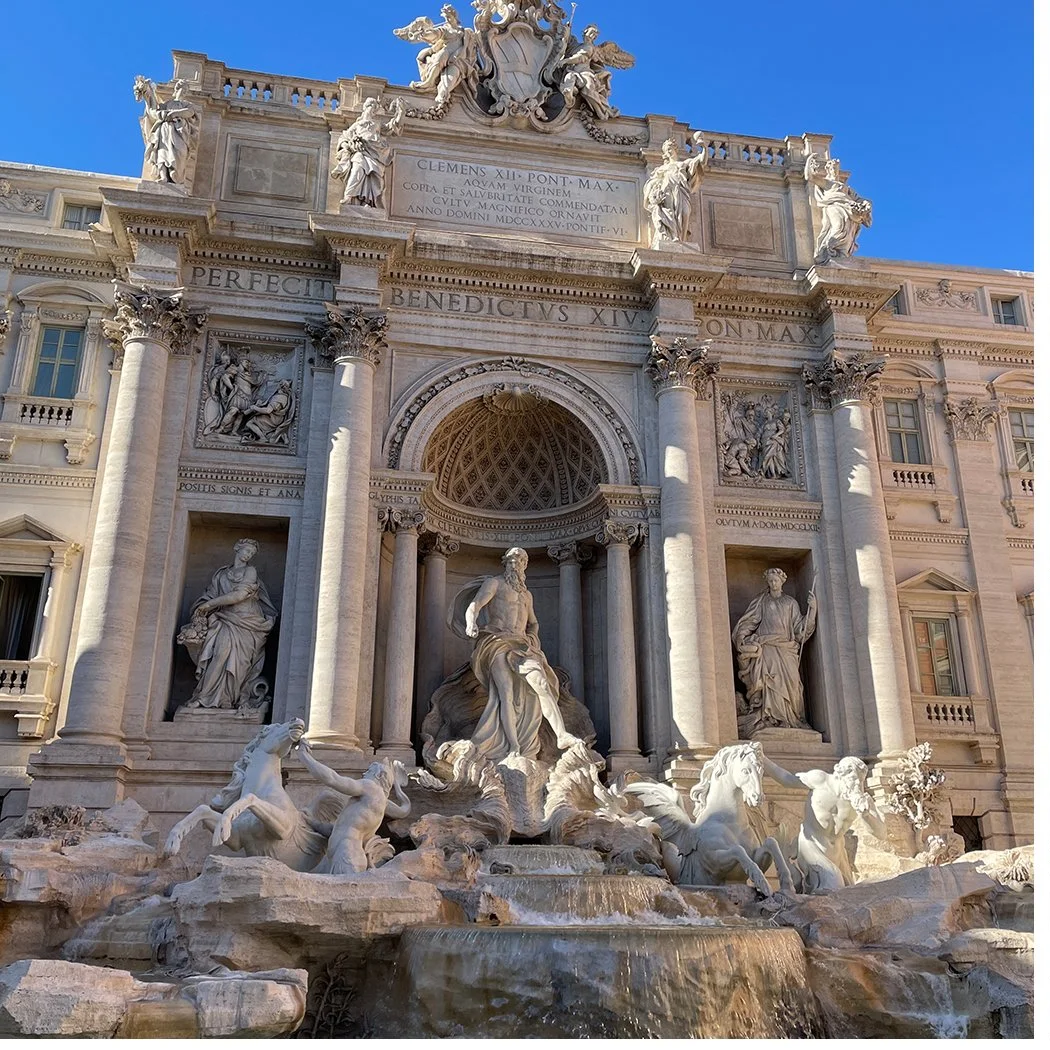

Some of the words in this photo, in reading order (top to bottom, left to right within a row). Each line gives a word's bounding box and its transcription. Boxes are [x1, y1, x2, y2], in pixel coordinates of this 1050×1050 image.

[416, 159, 487, 178] CLEMENS
[463, 178, 507, 191] AQVAM
[513, 183, 572, 198] VIRGINEM
[402, 181, 438, 194] COPIA
[443, 186, 456, 196] ET
[460, 188, 534, 205] SALVBRITATE
[539, 197, 629, 215] COMMENDATAM
[407, 204, 442, 216] ANNO
[446, 208, 490, 222] DOMINI
[432, 196, 472, 209] CVLTV
[477, 201, 544, 217] MAGNIFICO
[549, 210, 602, 223] ORNAVIT
[189, 266, 332, 298] PERFECIT
[390, 287, 569, 323] BENEDICTVS
[179, 482, 216, 492] POSITIS
[220, 485, 252, 495] SIGNIS
[259, 488, 271, 497] ET
[277, 489, 301, 499] ANA
[368, 491, 404, 503] GLYPHIS
[716, 518, 750, 528] OLVTVM
